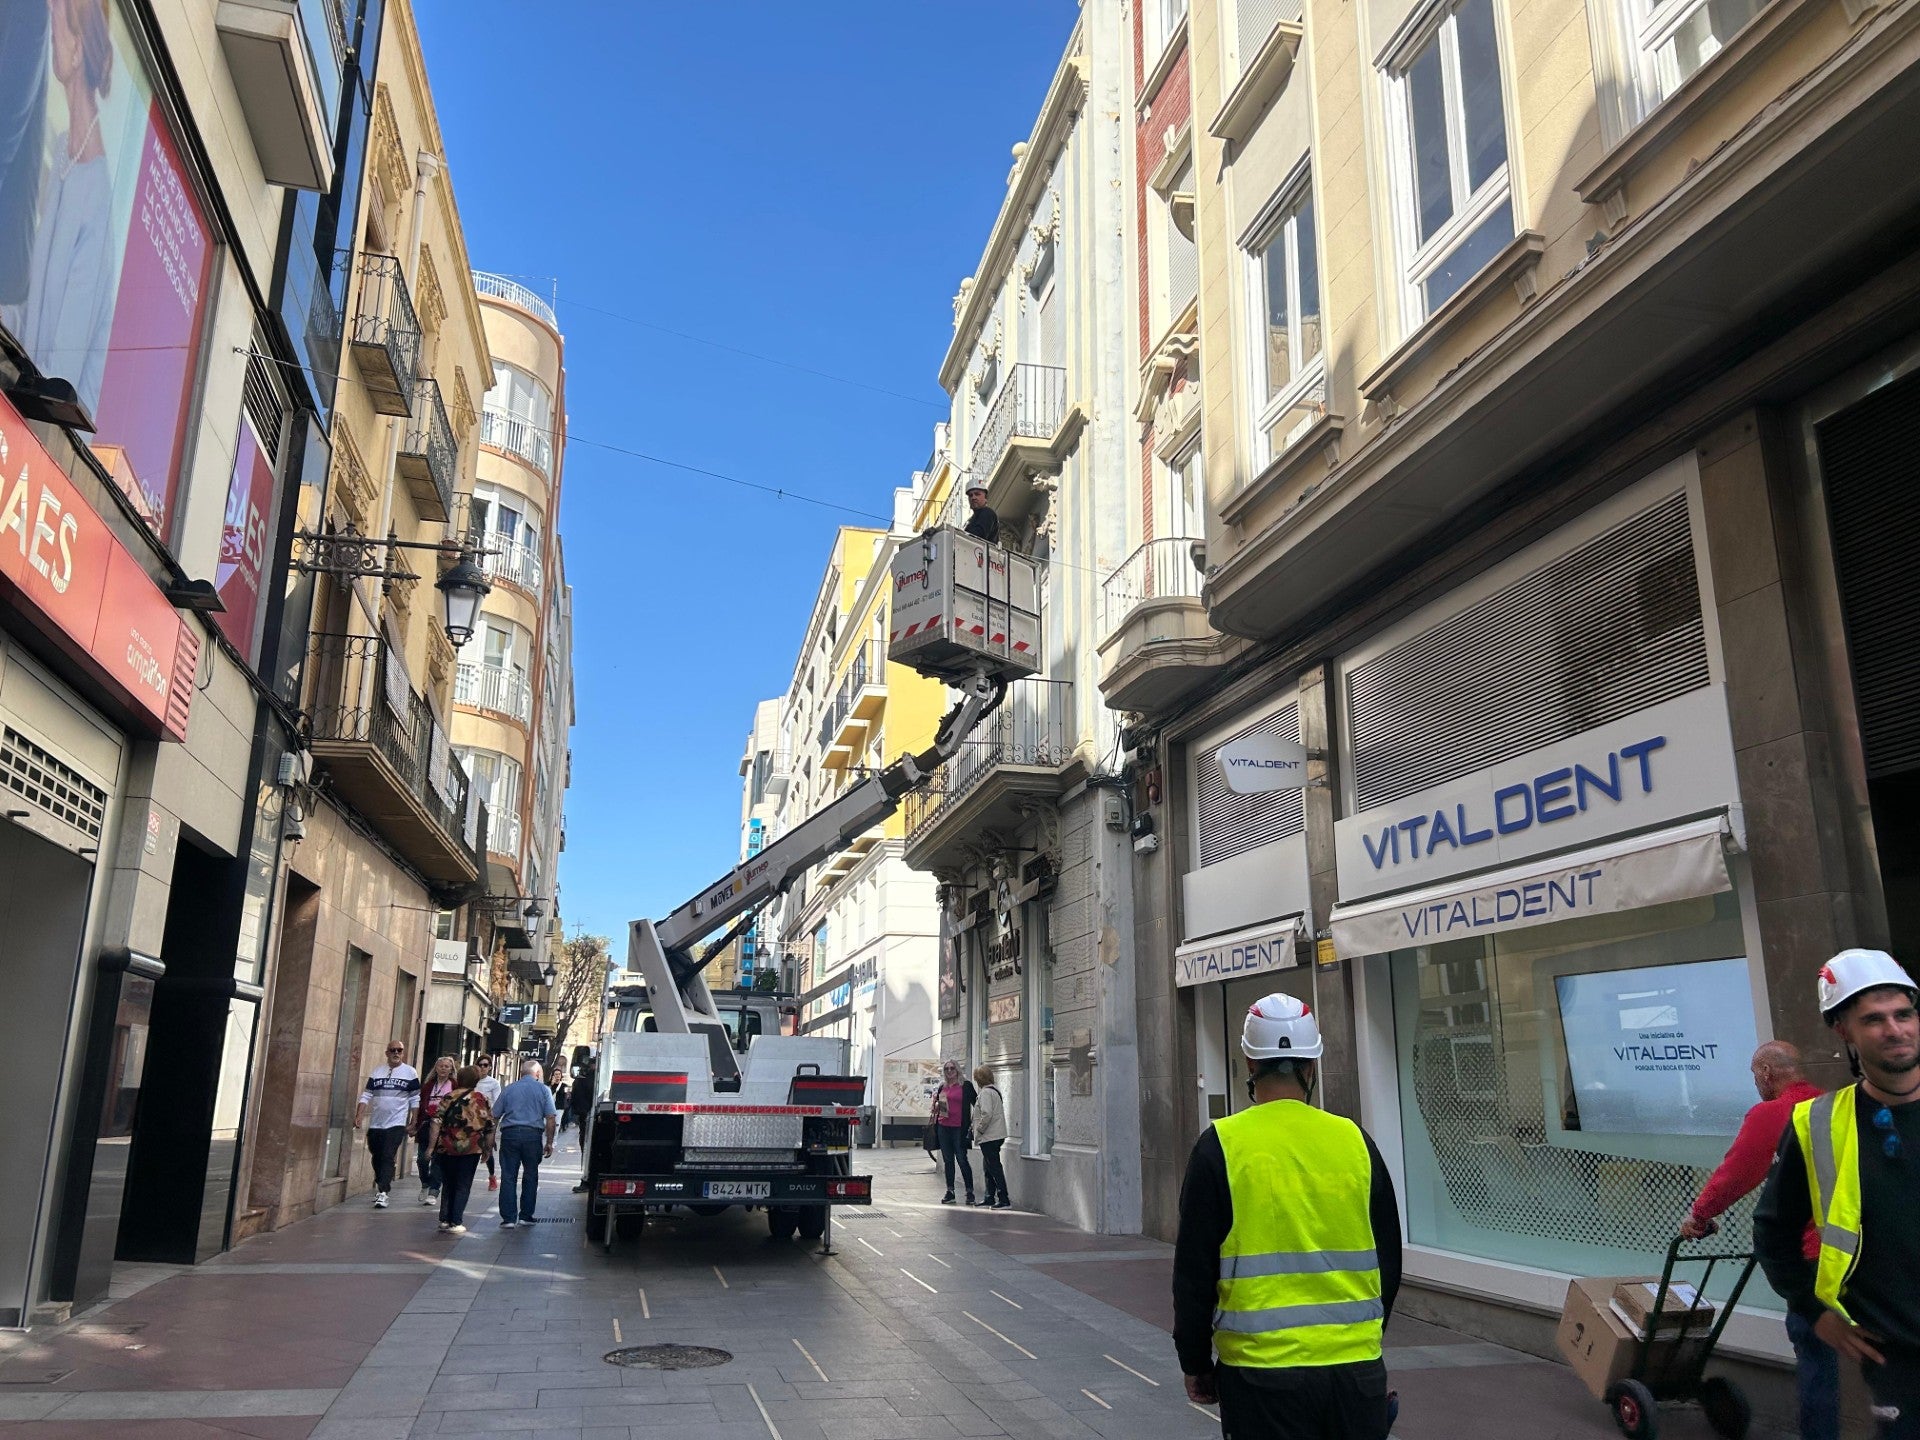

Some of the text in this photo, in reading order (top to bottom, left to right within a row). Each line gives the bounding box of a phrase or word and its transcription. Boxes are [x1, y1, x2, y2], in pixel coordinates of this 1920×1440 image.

[149, 160, 185, 244] MEJORANDO
[166, 168, 176, 193] DE
[175, 186, 184, 210] 70
[183, 209, 199, 247] AÑOS
[142, 205, 152, 231] DE
[150, 225, 163, 257] LAS
[145, 181, 199, 303] LA CALIDAD DE VIDA
[127, 643, 167, 698] amplifon
[1228, 758, 1300, 770] VITALDENT
[1363, 735, 1667, 870] VITALDENT
[1402, 869, 1602, 938] VITALDENT
[434, 952, 459, 961] GULLÓ
[1183, 939, 1285, 980] VITALDENT
[1613, 1044, 1718, 1061] VITALDENT
[654, 1183, 684, 1191] IVECO
[711, 1183, 768, 1195] 8424 MTK
